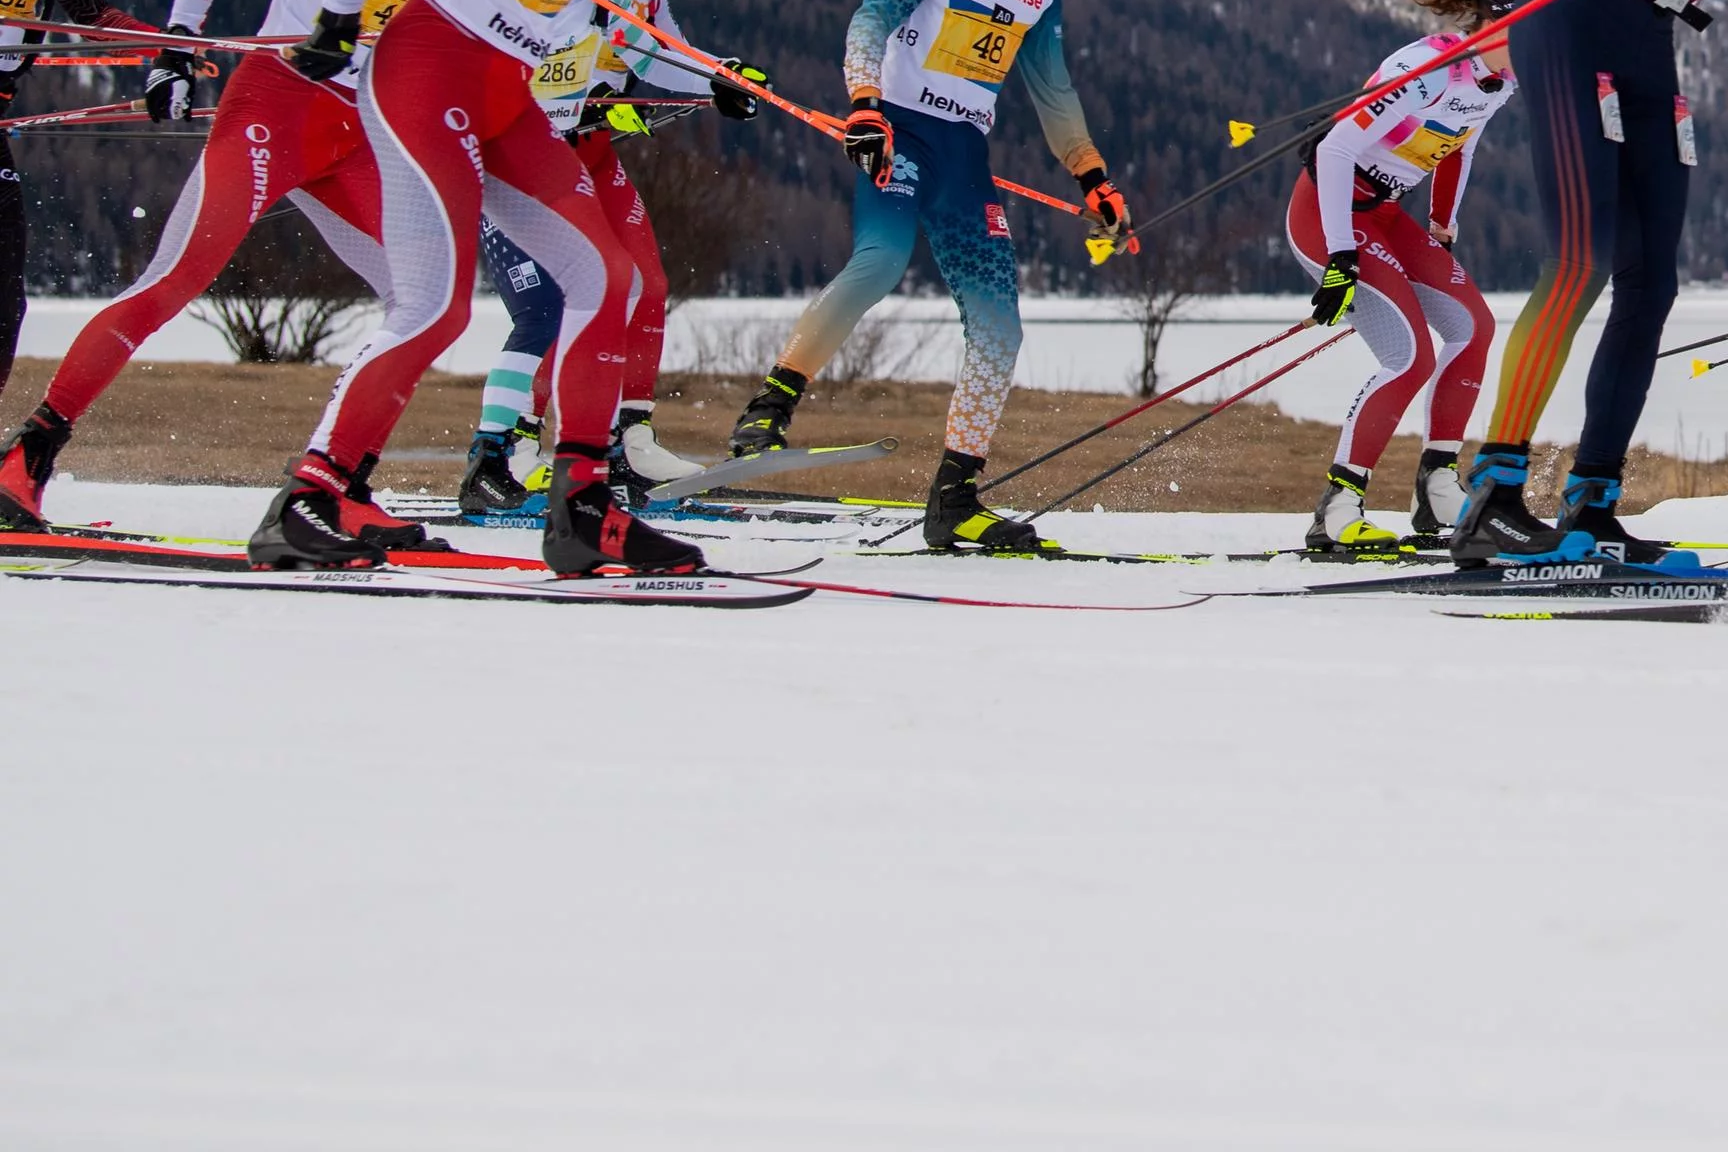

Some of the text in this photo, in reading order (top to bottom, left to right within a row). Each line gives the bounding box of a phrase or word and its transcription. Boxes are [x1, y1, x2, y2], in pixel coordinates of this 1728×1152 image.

[373, 3, 398, 25] 4
[896, 25, 919, 47] 48
[972, 31, 1007, 64] 48
[538, 60, 577, 84] 286
[301, 464, 347, 494] MADSHUS
[1356, 554, 1401, 562] FISCHER
[312, 573, 374, 583] MADSHUS
[1502, 564, 1604, 583] SALOMON
[634, 580, 705, 592] MADSHUS
[1610, 585, 1716, 600] SALOMON
